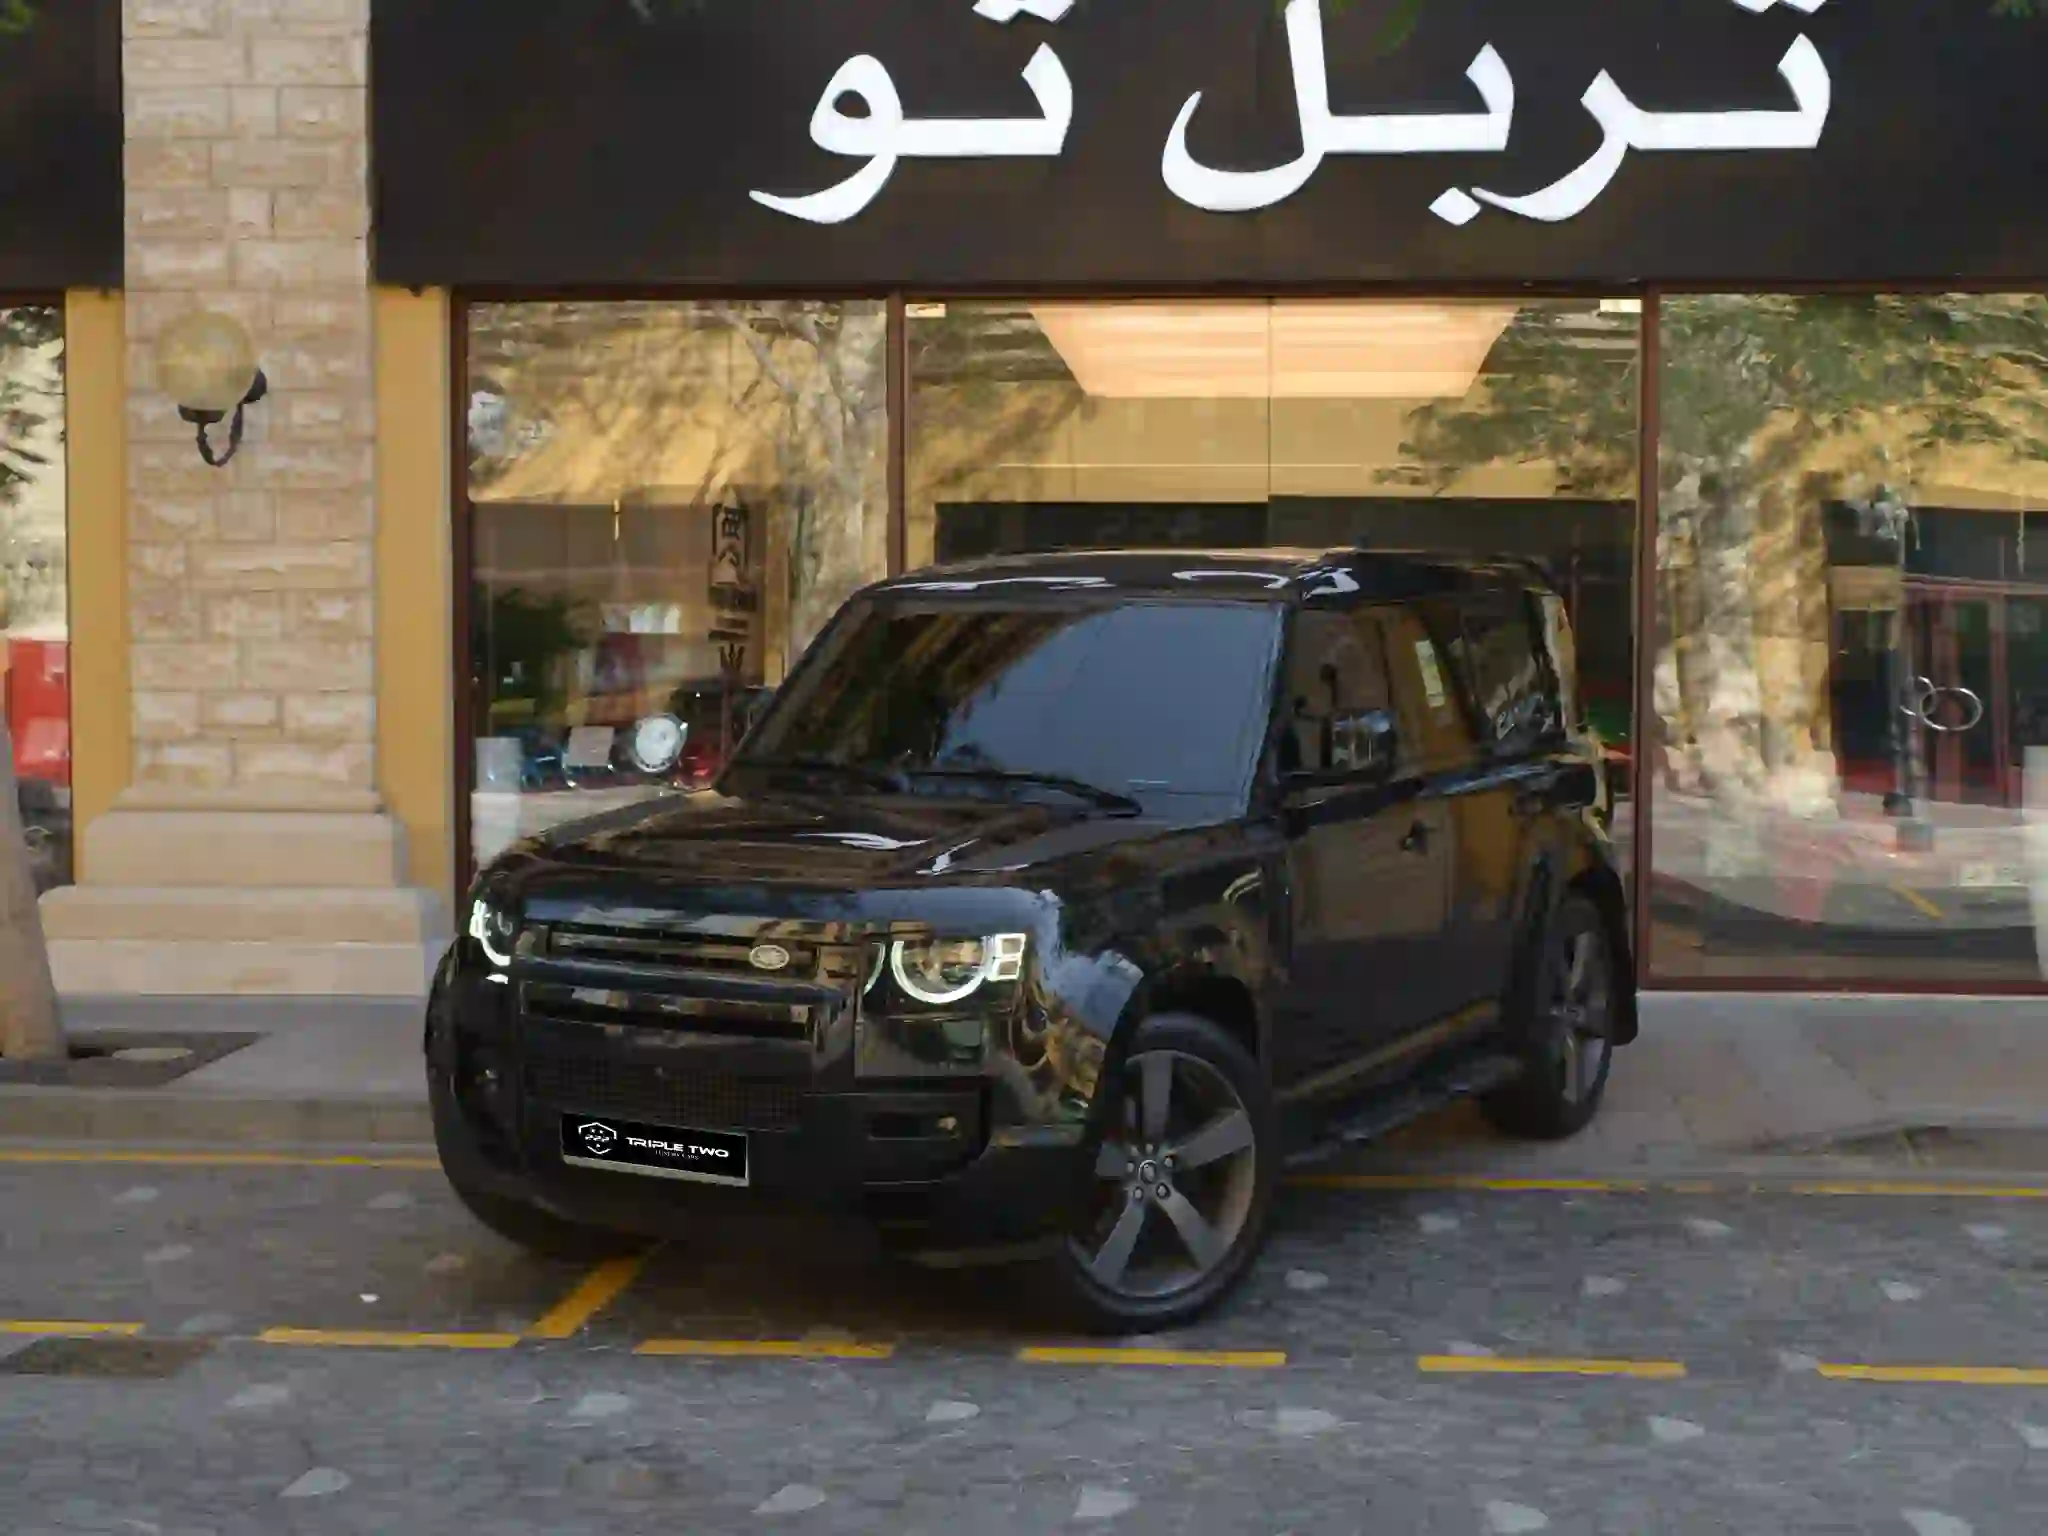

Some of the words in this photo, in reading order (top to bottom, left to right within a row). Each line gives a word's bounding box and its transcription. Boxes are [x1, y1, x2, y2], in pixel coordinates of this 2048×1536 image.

[749, 0, 1074, 224] تو
[626, 1137, 684, 1152] TRIPLE
[688, 1145, 729, 1158] TWO
